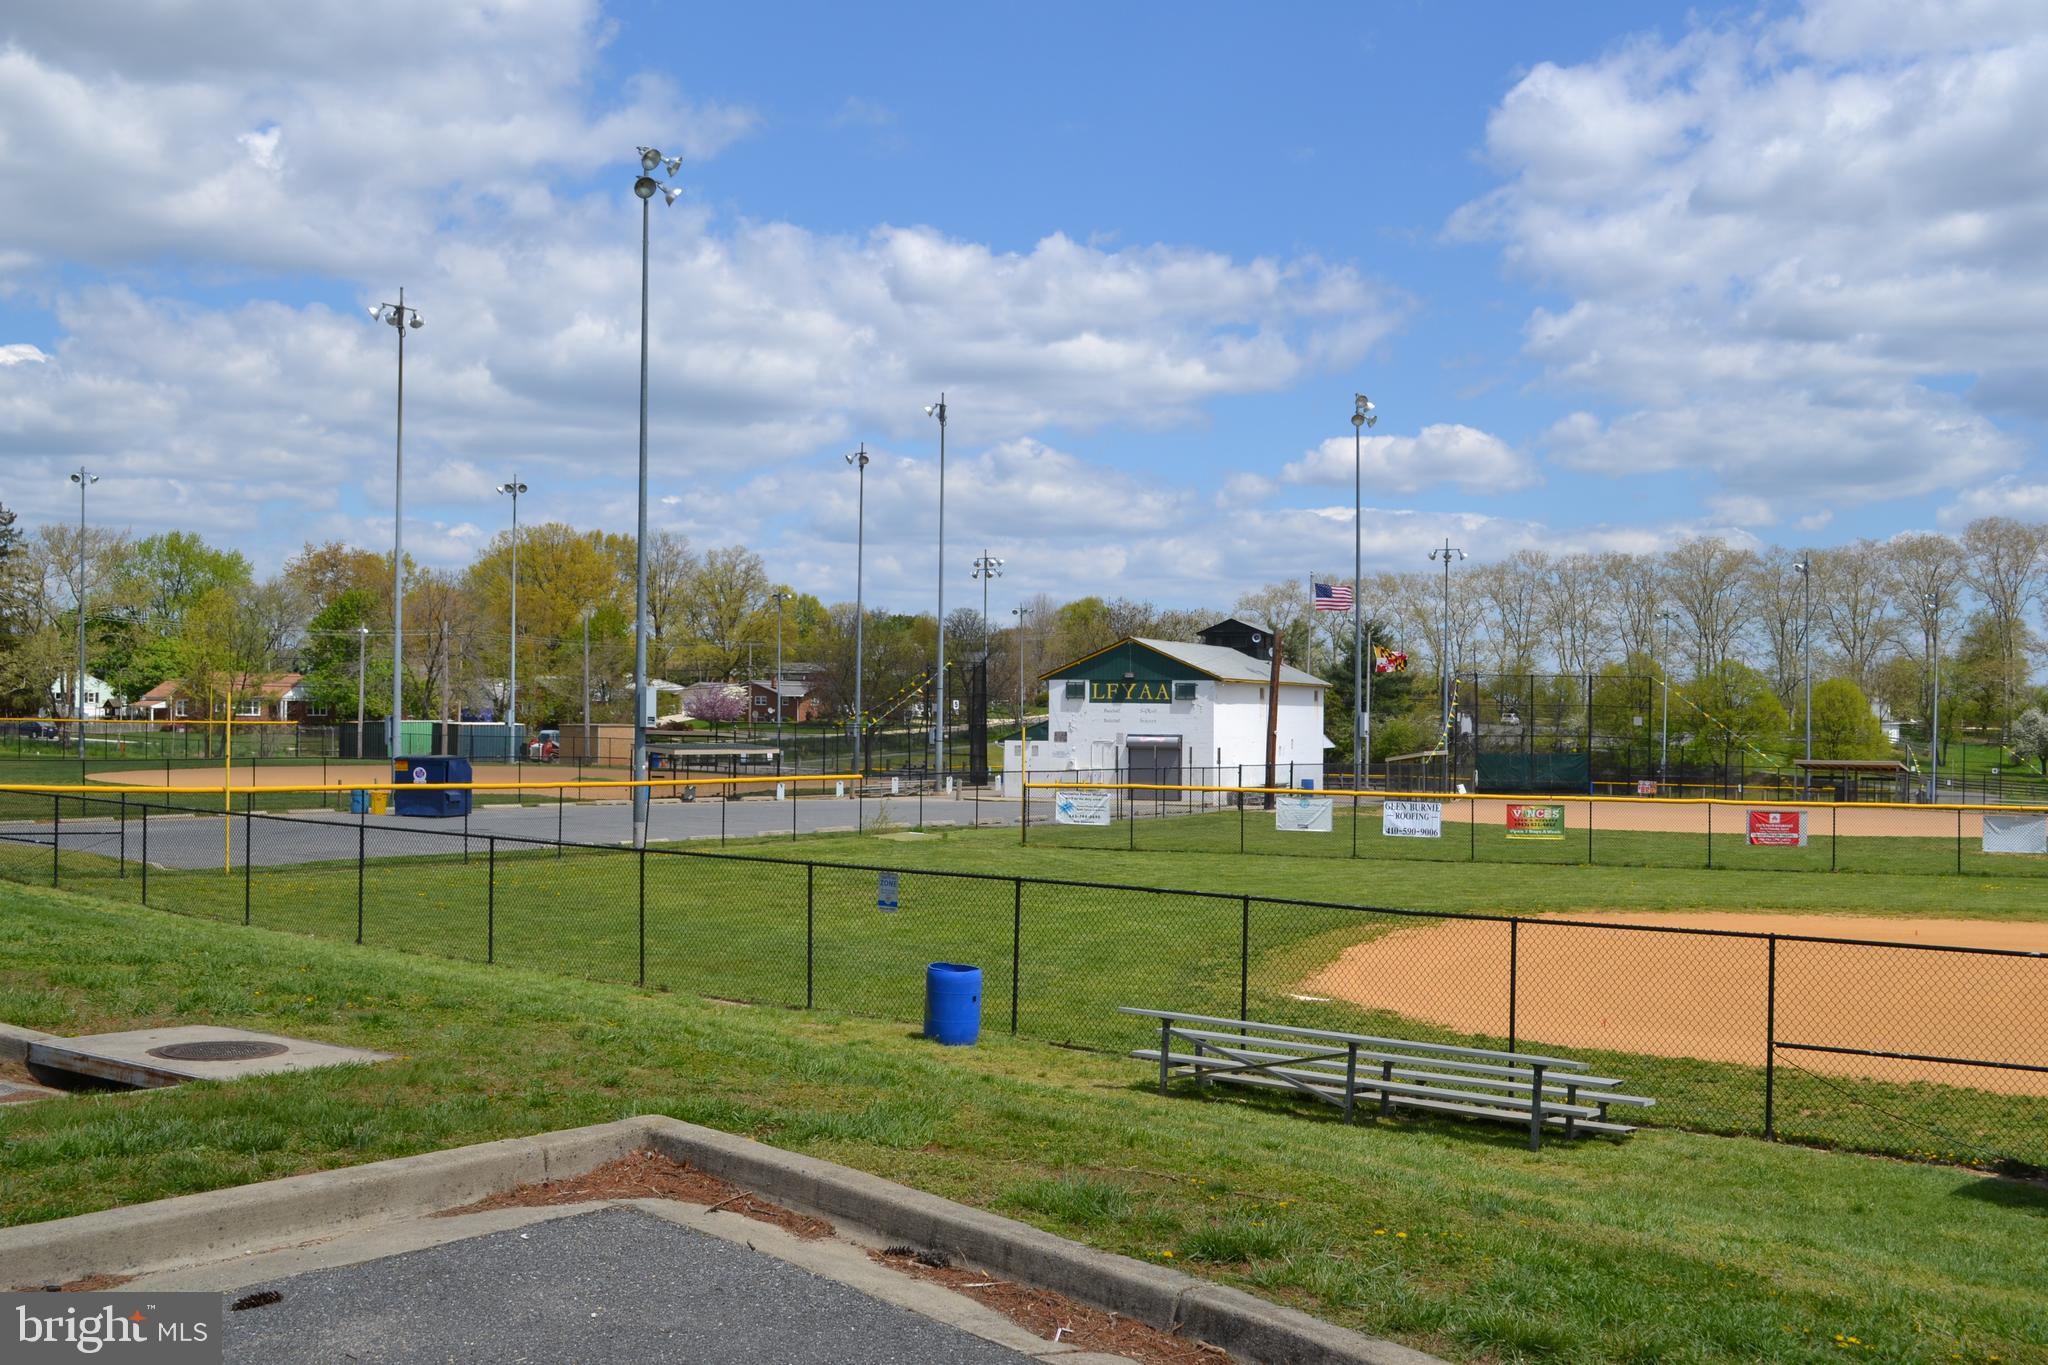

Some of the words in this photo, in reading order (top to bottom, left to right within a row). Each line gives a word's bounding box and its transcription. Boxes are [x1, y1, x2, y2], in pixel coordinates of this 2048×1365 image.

[1091, 682, 1170, 700] LFYAA
[1385, 802, 1407, 811] GLEN
[1409, 803, 1440, 812] BURNIE
[1395, 812, 1429, 820] ROOFING
[1385, 827, 1439, 836] 410-590-9006
[880, 879, 897, 887] ZONE
